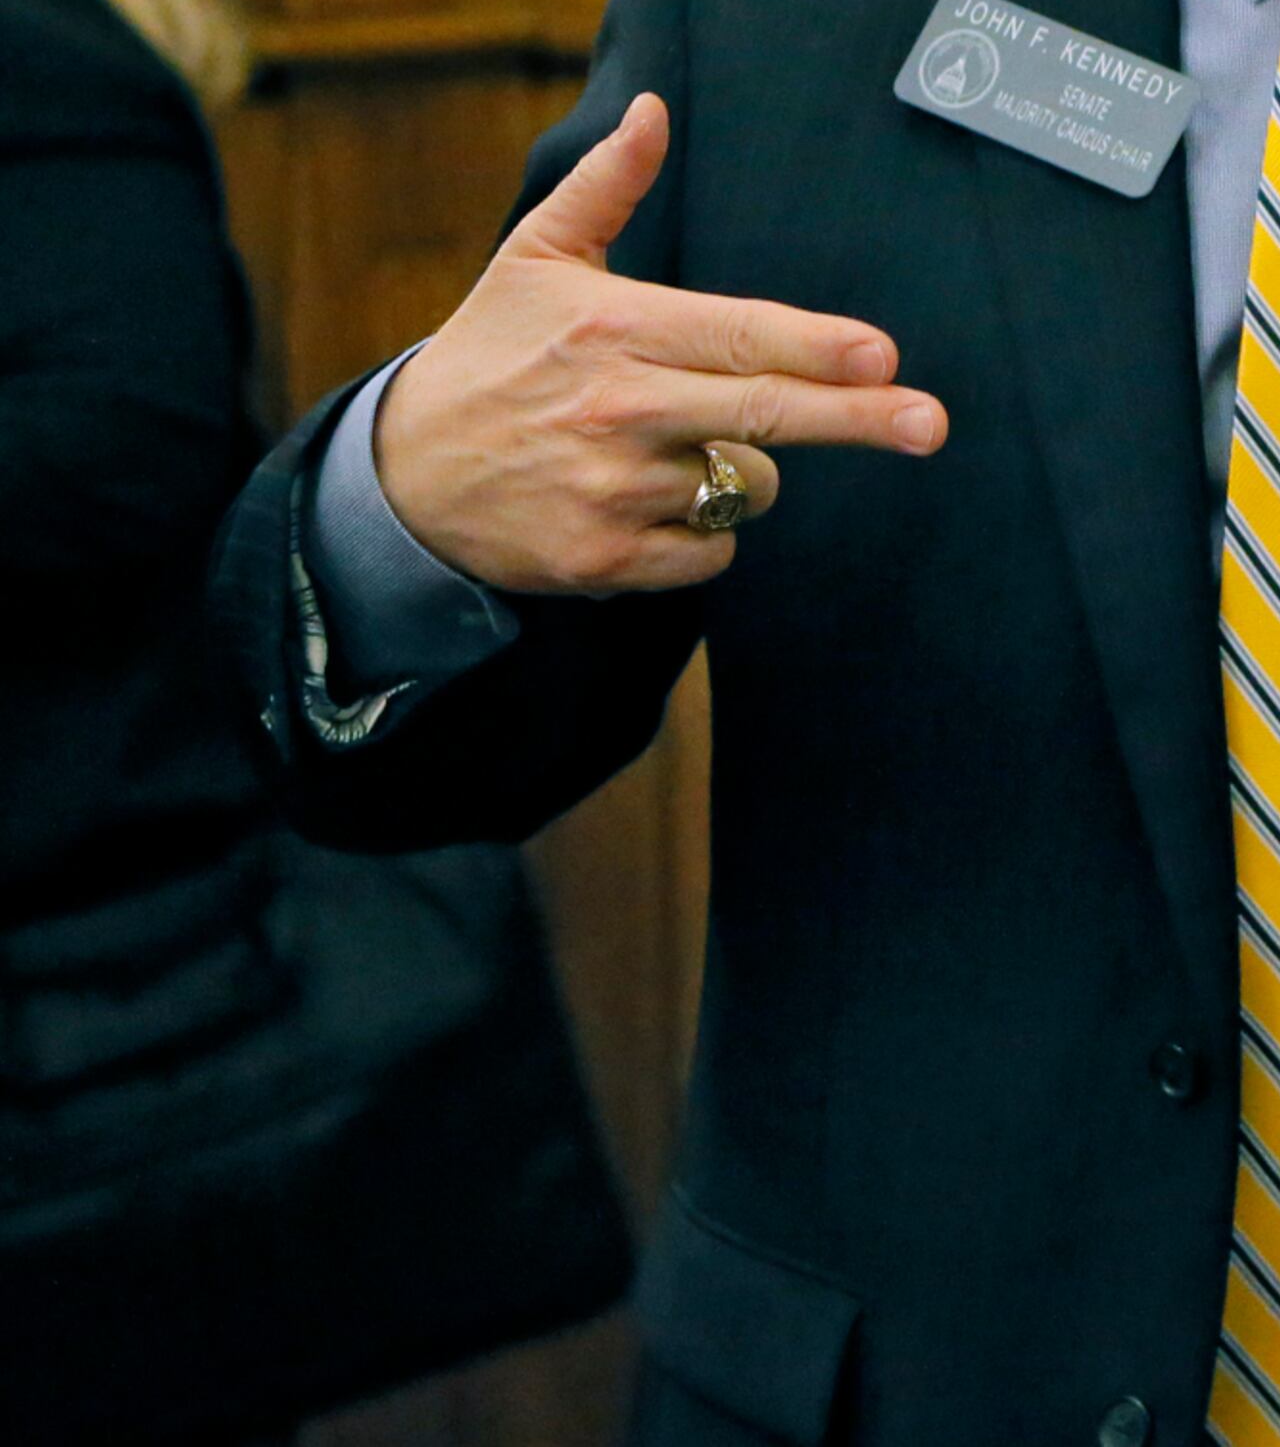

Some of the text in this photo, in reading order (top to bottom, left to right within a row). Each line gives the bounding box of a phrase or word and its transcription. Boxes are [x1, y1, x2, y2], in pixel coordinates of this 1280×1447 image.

[1029, 25, 1050, 54] F.
[1060, 38, 1184, 105] KENNEDY
[1058, 83, 1113, 121] SENATE
[993, 90, 1153, 173] MAJORITY CAUCUS CHAIR
